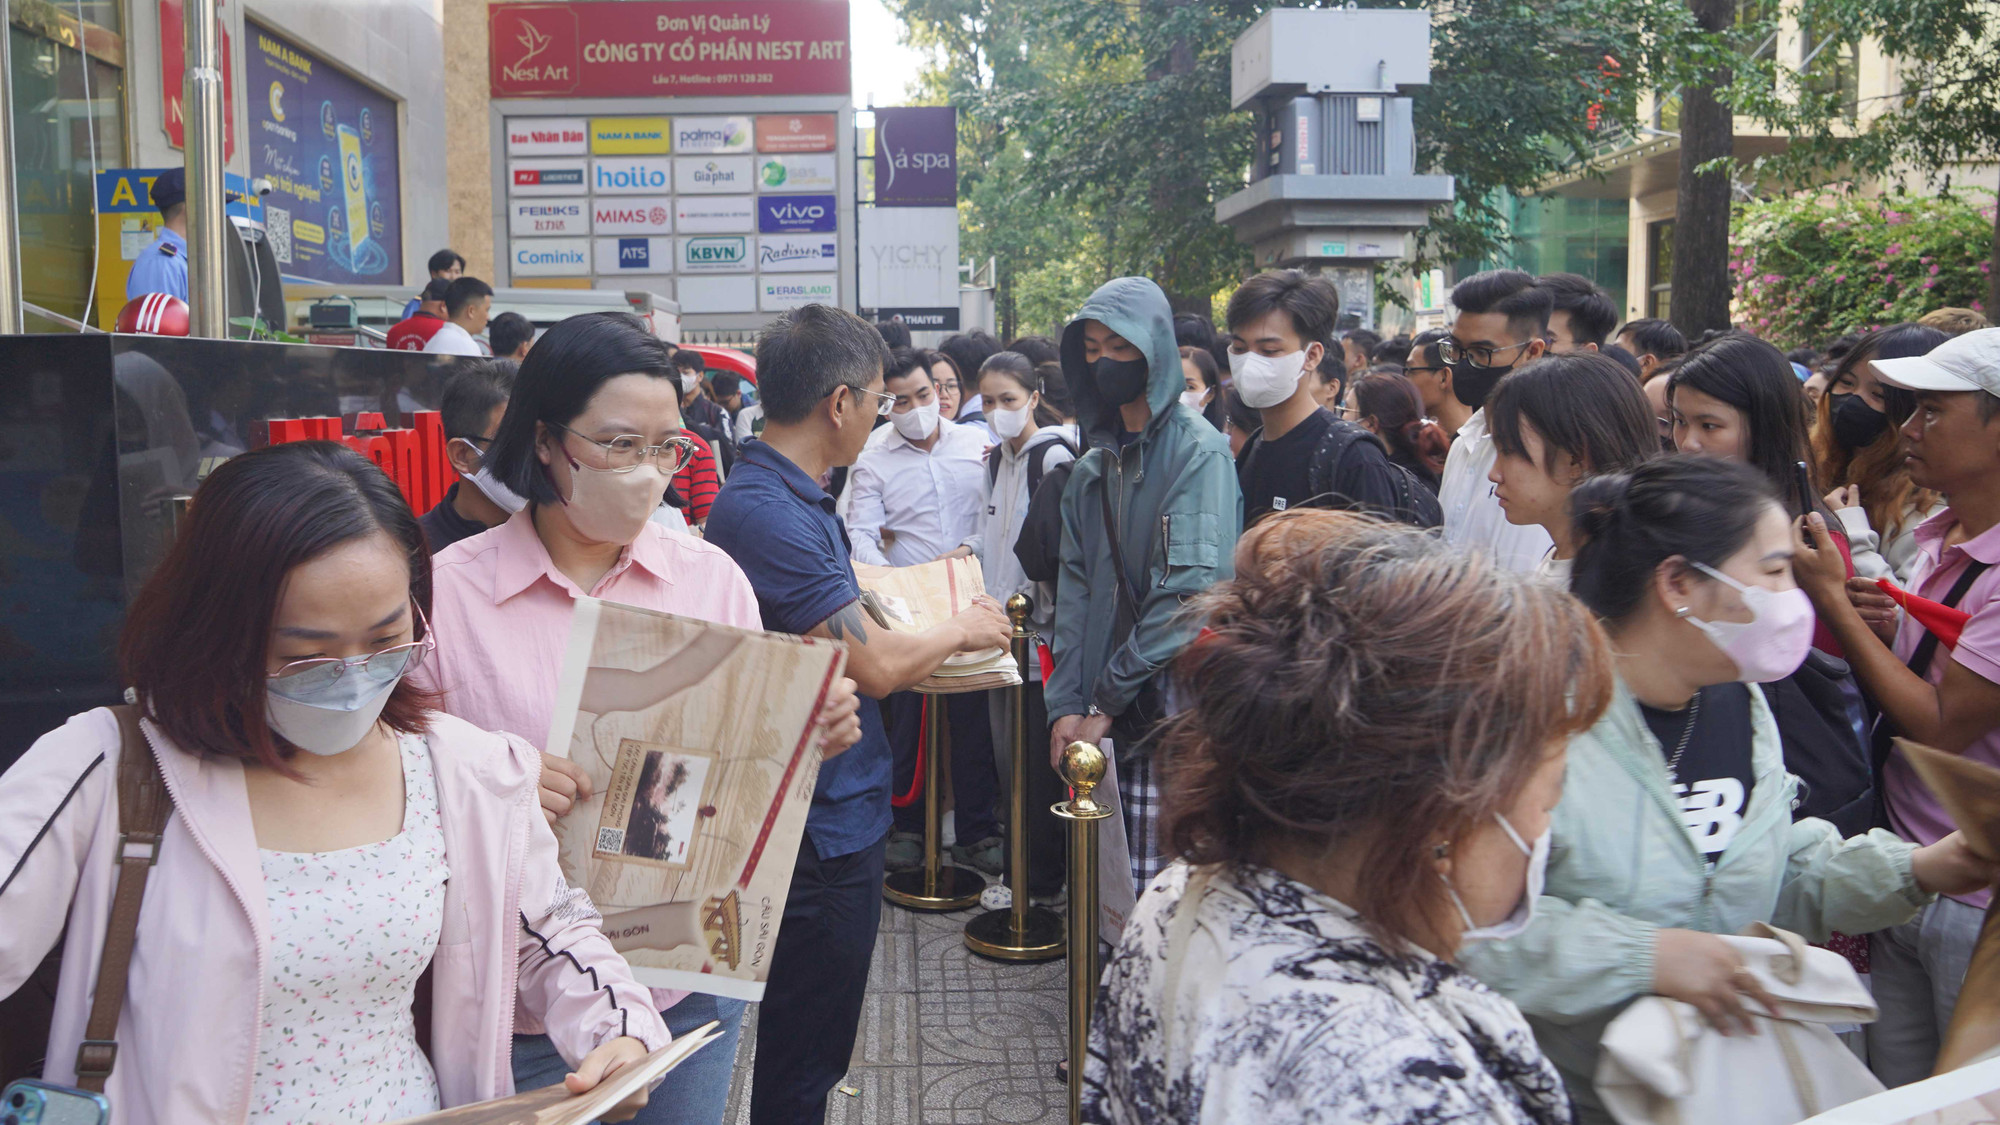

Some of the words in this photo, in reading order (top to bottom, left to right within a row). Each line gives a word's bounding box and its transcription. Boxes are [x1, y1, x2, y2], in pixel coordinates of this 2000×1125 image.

[656, 14, 689, 32] Đơn
[691, 14, 706, 35] Vị
[709, 13, 749, 33] Quản
[753, 14, 770, 34] Lý
[259, 34, 281, 59] NAM
[583, 40, 638, 63] CÔNG
[641, 43, 665, 62] TY
[669, 35, 695, 62] CỔ
[756, 41, 804, 61] NEST
[808, 41, 845, 60] ART
[503, 65, 540, 81] Nest
[543, 64, 569, 81] Art
[717, 74, 738, 84] 0971
[597, 132, 622, 141] NAM
[624, 132, 632, 140] A
[633, 132, 663, 140] BANK
[680, 128, 722, 148] palma
[912, 152, 950, 174] spa
[595, 209, 647, 224] MIMS
[769, 203, 825, 219] vivo
[517, 250, 585, 265] Cominix
[621, 247, 647, 260] ATS
[691, 246, 735, 259] KBVN
[760, 242, 820, 265] Radisson
[869, 244, 948, 264] VICHY
[776, 285, 832, 296] ERASLAND
